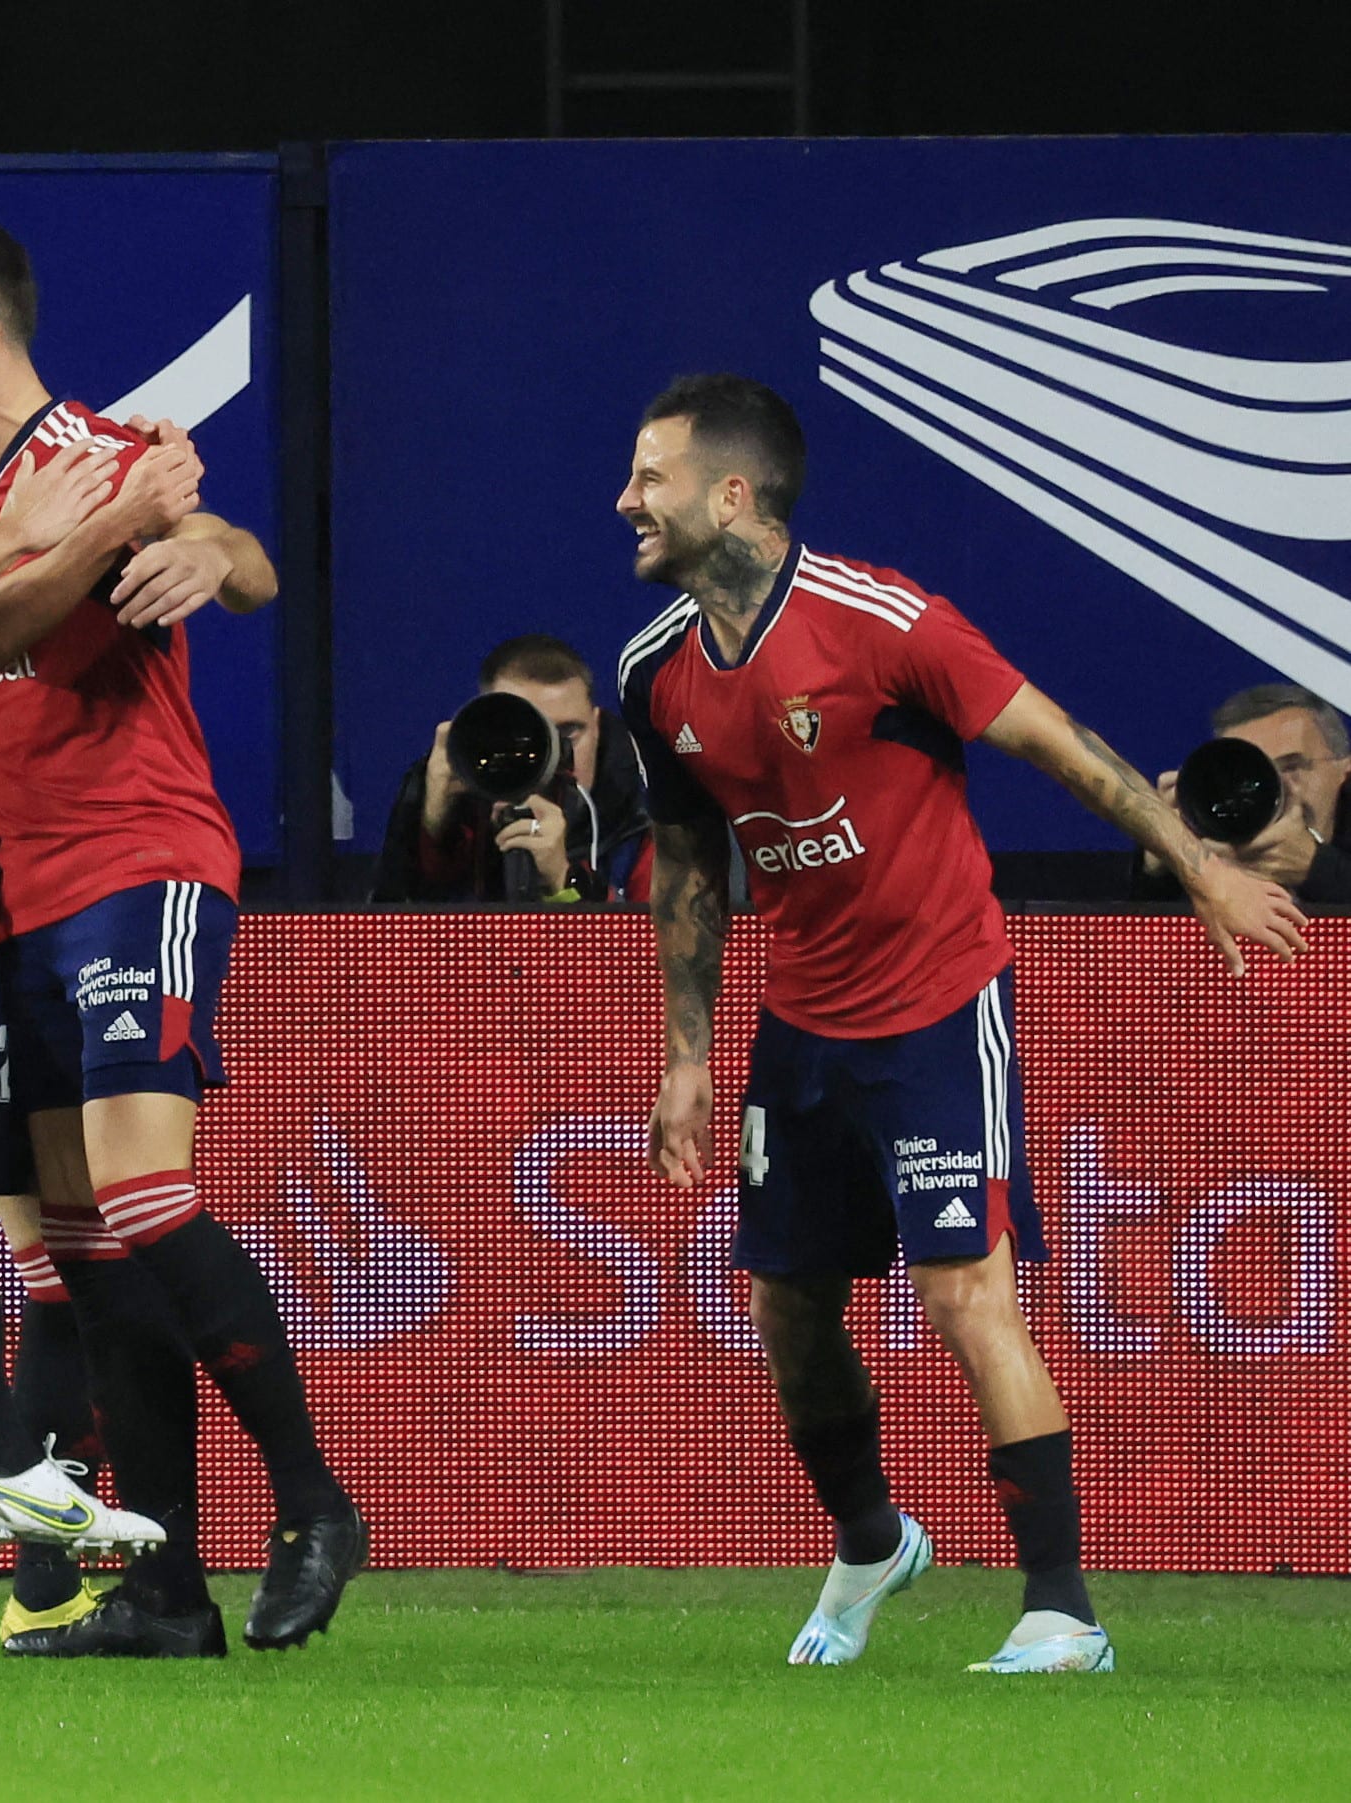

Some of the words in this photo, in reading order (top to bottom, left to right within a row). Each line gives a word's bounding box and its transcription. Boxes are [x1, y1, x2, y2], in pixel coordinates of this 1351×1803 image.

[750, 817, 865, 872] erleal
[88, 988, 148, 1007] Navarra
[104, 1029, 146, 1041] adidas
[911, 1173, 978, 1191] Navarra
[934, 1217, 976, 1228] adidas
